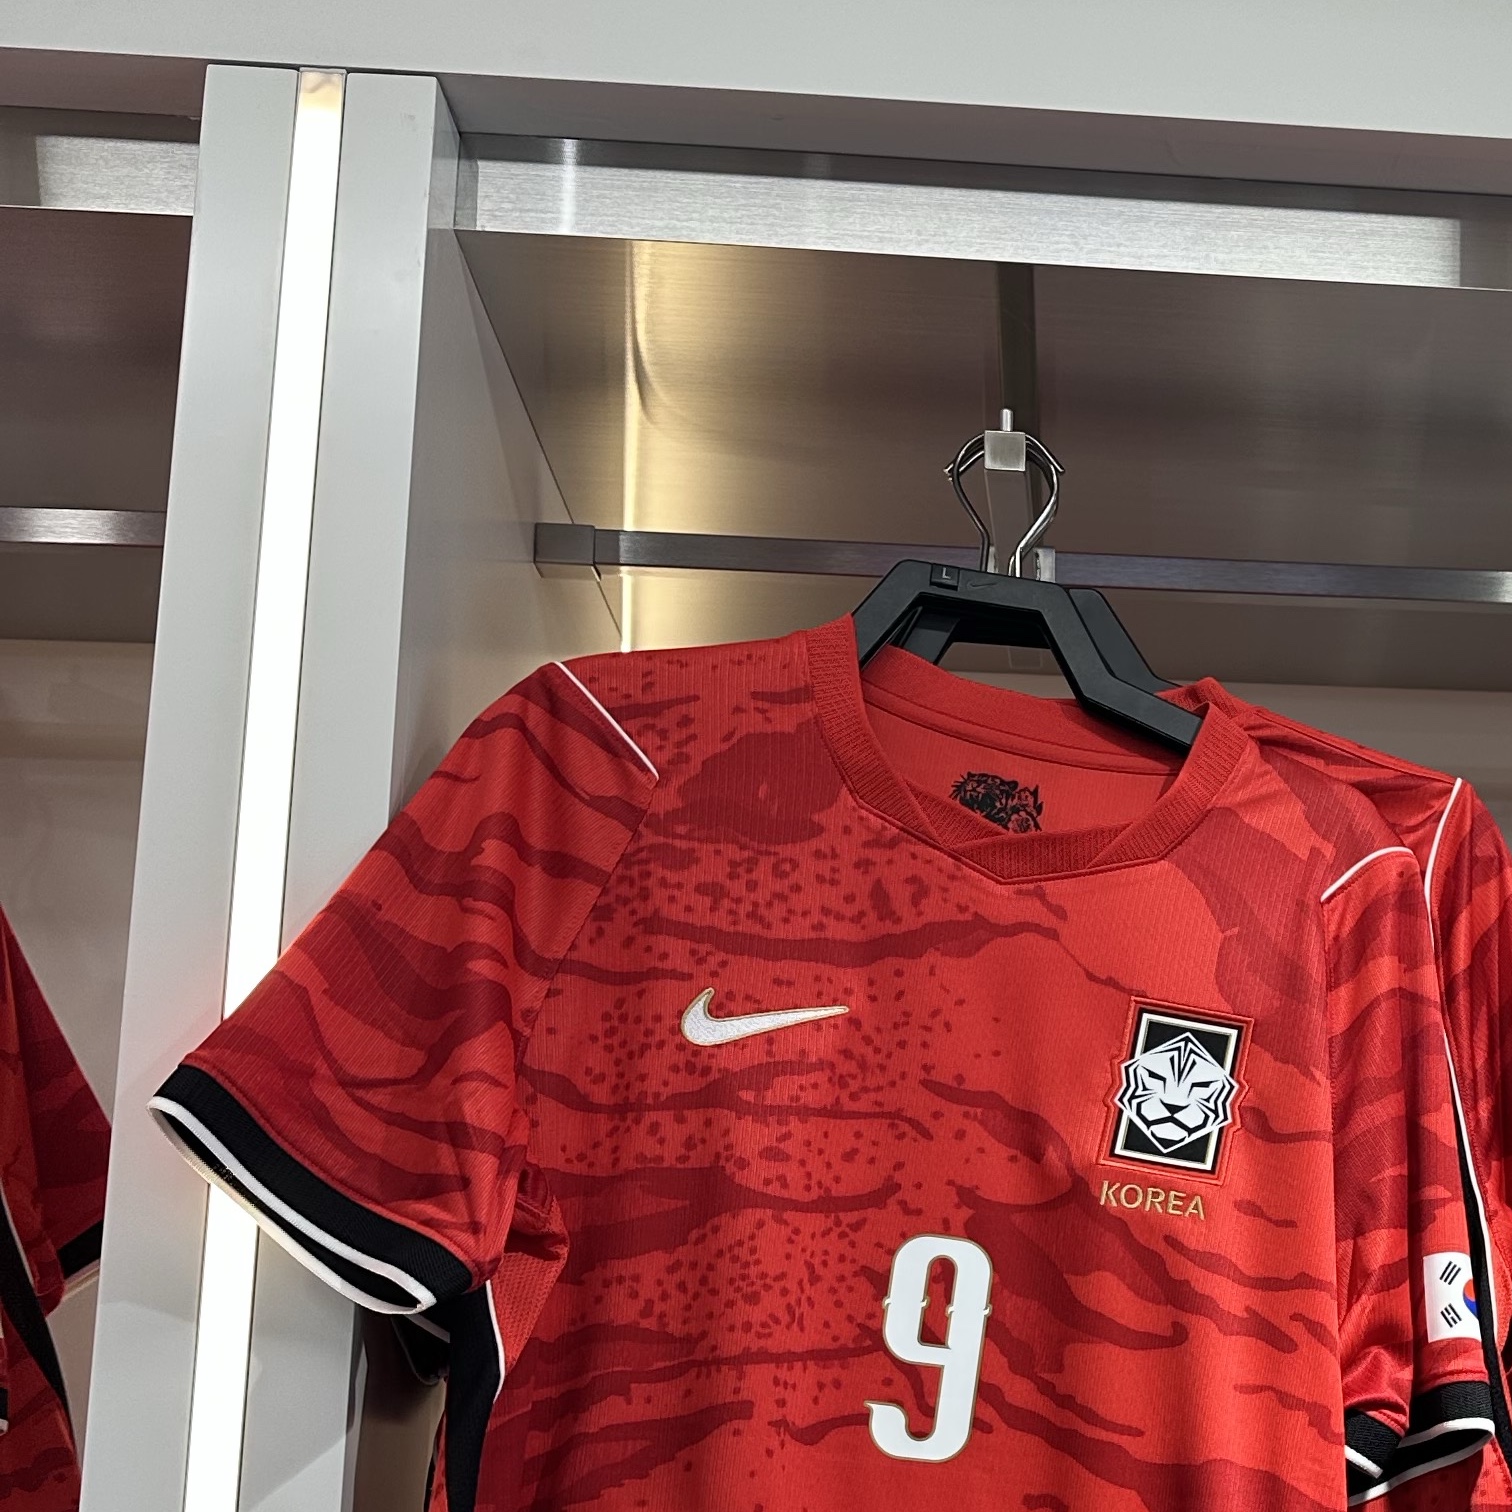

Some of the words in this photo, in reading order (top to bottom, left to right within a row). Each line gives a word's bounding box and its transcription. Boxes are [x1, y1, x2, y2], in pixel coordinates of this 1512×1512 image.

[942, 567, 951, 579] L
[1100, 1180, 1205, 1220] KOREA
[864, 1233, 993, 1463] 9
